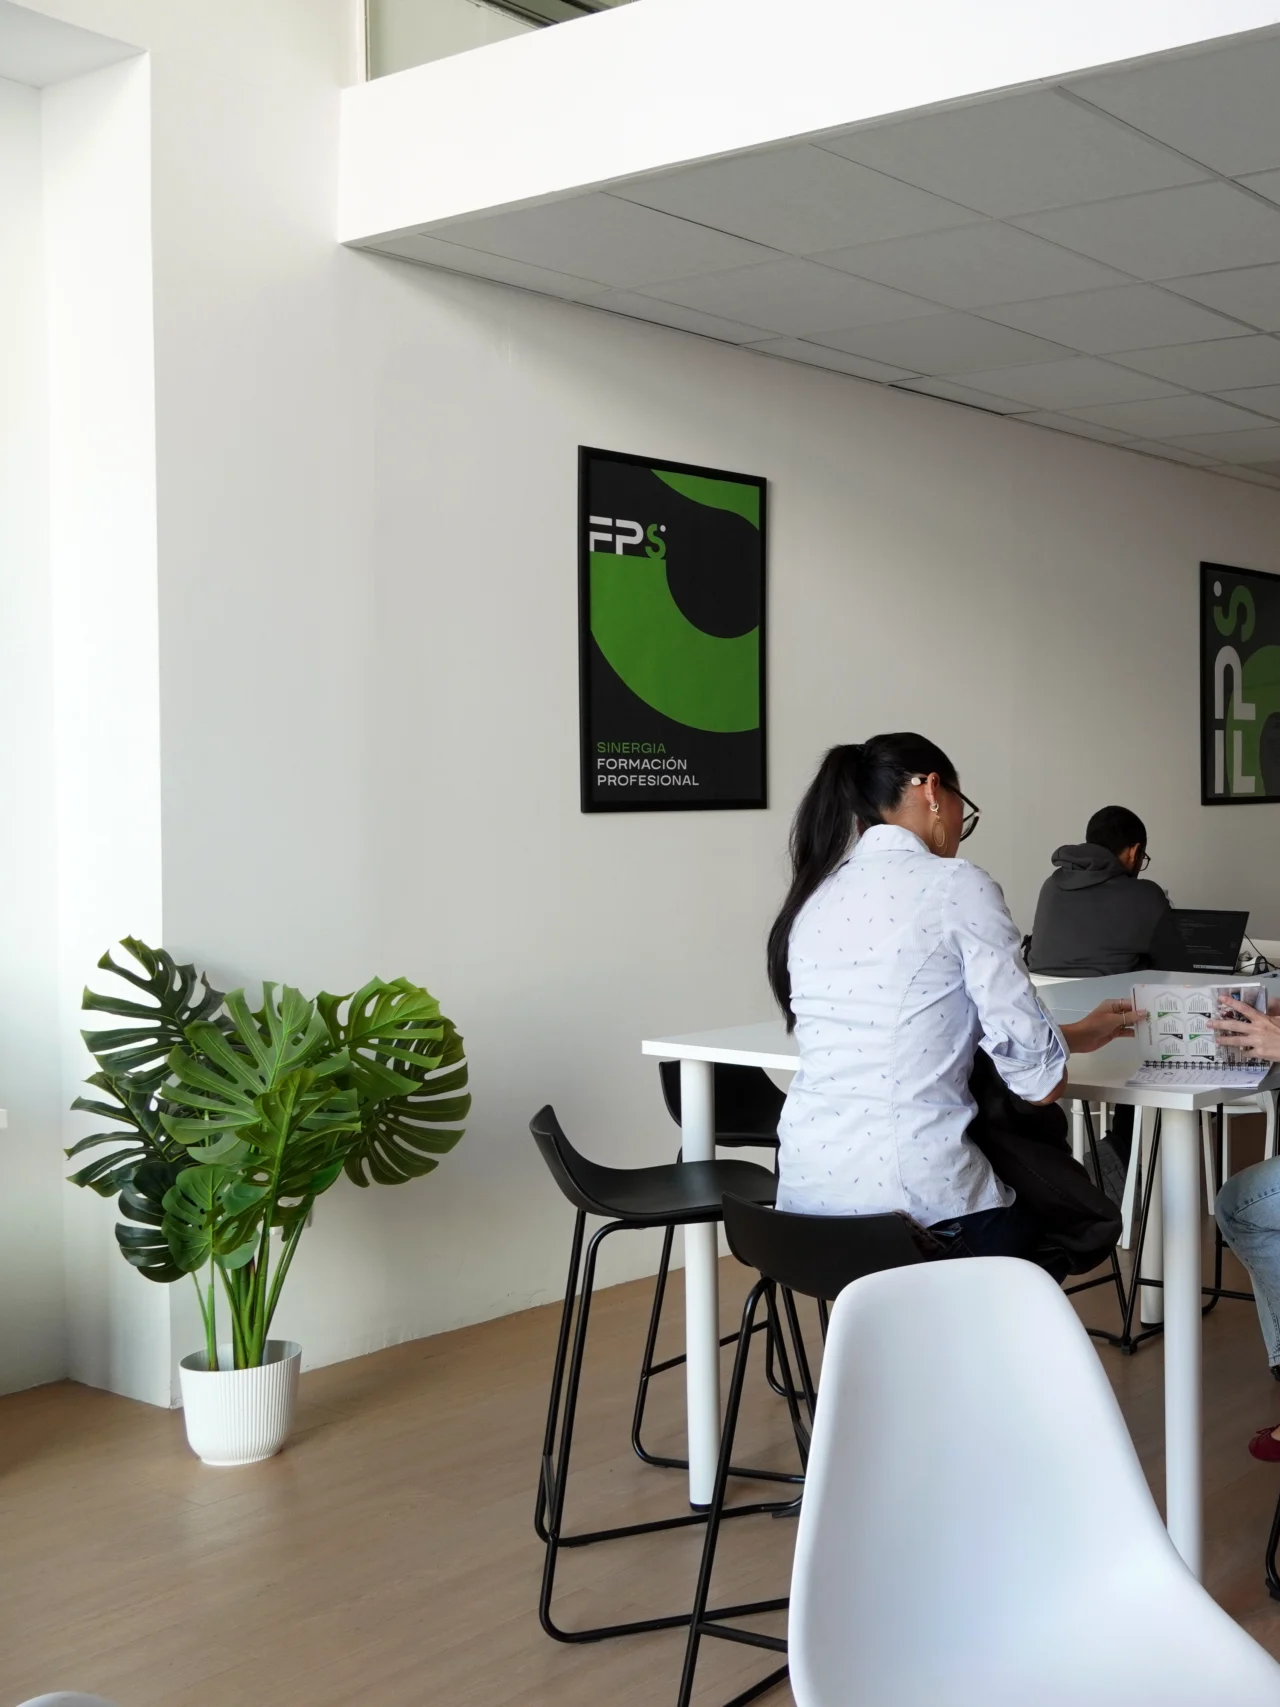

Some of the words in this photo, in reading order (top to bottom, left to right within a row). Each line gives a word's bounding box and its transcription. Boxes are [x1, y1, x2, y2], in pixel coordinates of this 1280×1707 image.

[597, 742, 666, 754] SINERGIA
[597, 756, 687, 770] FORMACIÓN
[597, 775, 700, 786] PROFESIONAL
